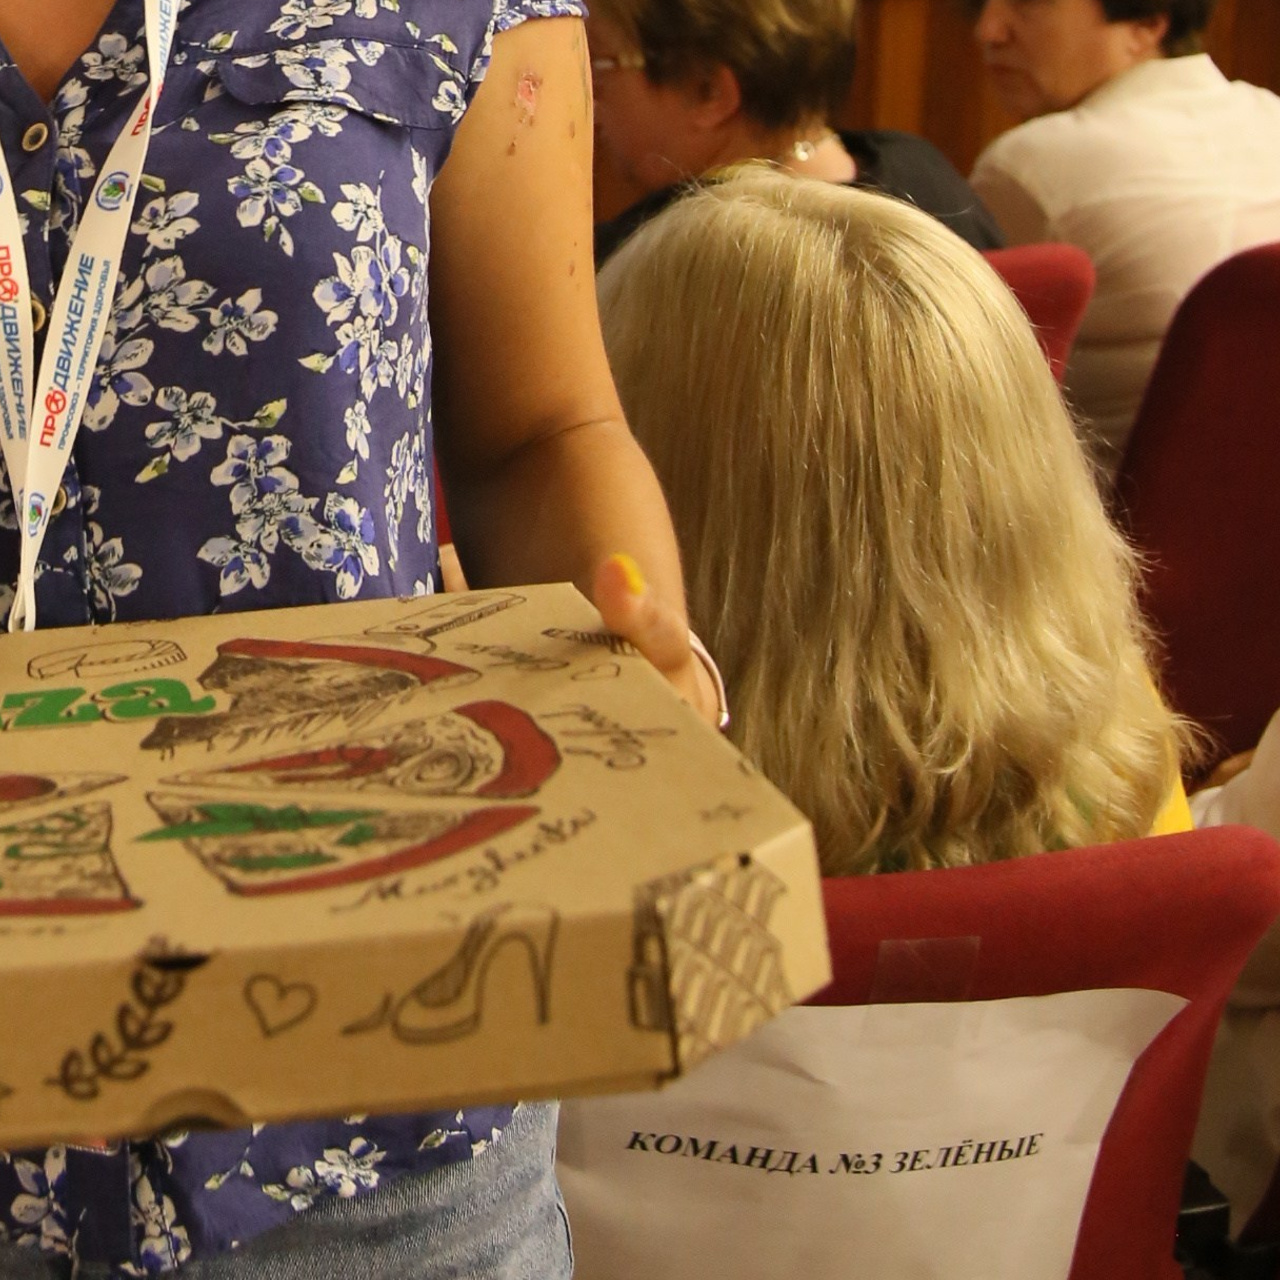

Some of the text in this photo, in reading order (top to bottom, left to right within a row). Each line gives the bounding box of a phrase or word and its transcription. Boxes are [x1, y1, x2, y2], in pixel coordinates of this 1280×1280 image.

[625, 1129, 1045, 1175] КОМАНДА №3 ЗЕЛЁНЫЕ
